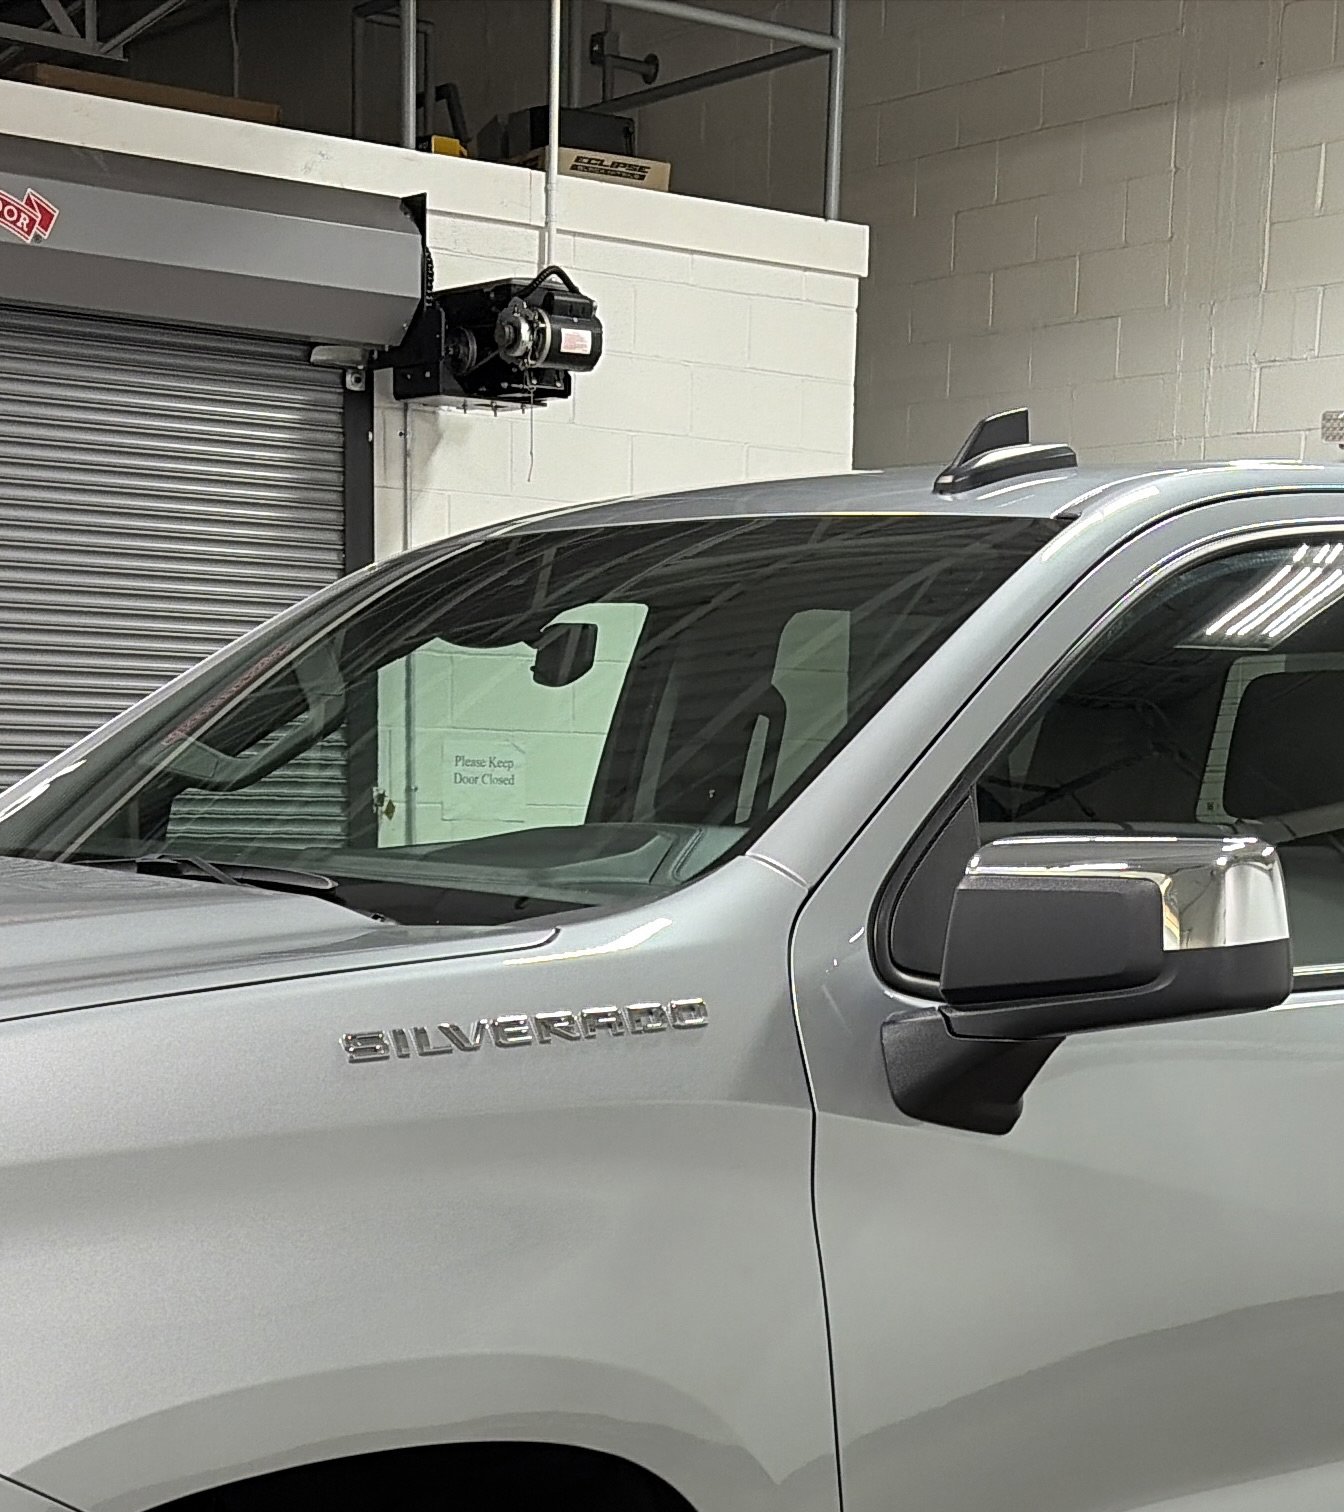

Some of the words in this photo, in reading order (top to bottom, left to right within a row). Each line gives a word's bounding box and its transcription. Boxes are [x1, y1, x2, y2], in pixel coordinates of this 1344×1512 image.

[574, 155, 651, 174] ECLIPSE
[454, 755, 486, 768] Please
[489, 756, 514, 771] Keep
[454, 772, 478, 785] Door
[481, 773, 515, 786] Closed
[339, 998, 709, 1064] SILVERADO
